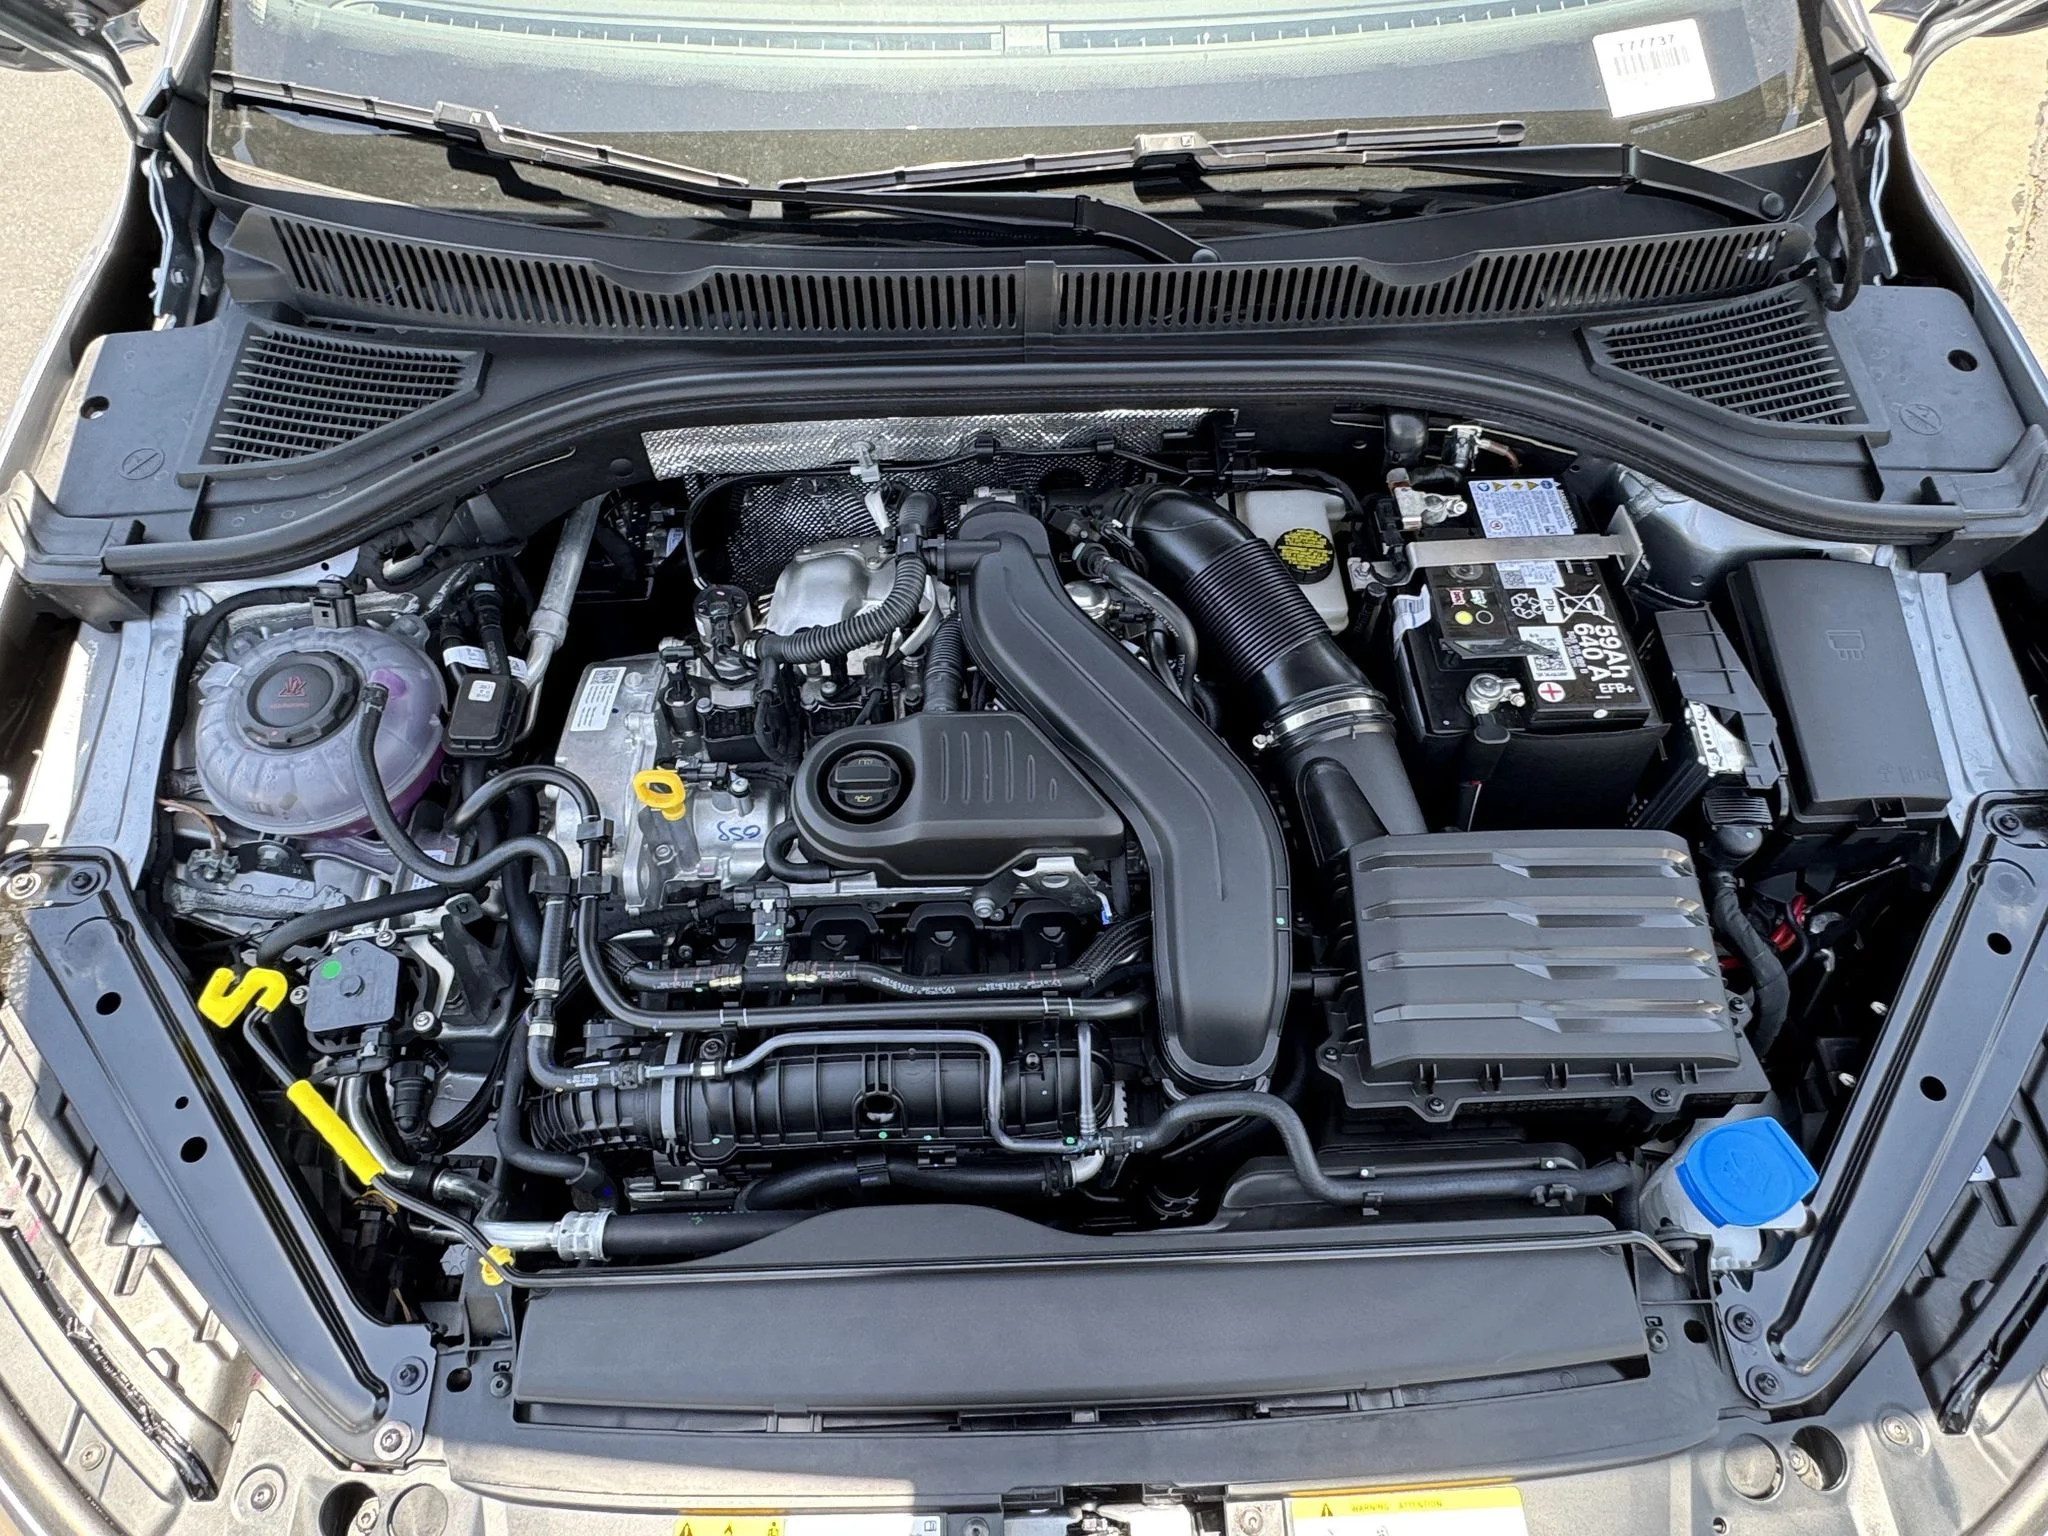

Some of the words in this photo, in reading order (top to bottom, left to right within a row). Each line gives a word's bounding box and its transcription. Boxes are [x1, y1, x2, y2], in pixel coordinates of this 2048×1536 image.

[1573, 623, 1605, 660] 640
[1595, 624, 1632, 678] 59Ah
[1587, 665, 1612, 682] A
[1598, 682, 1635, 694] EFB+
